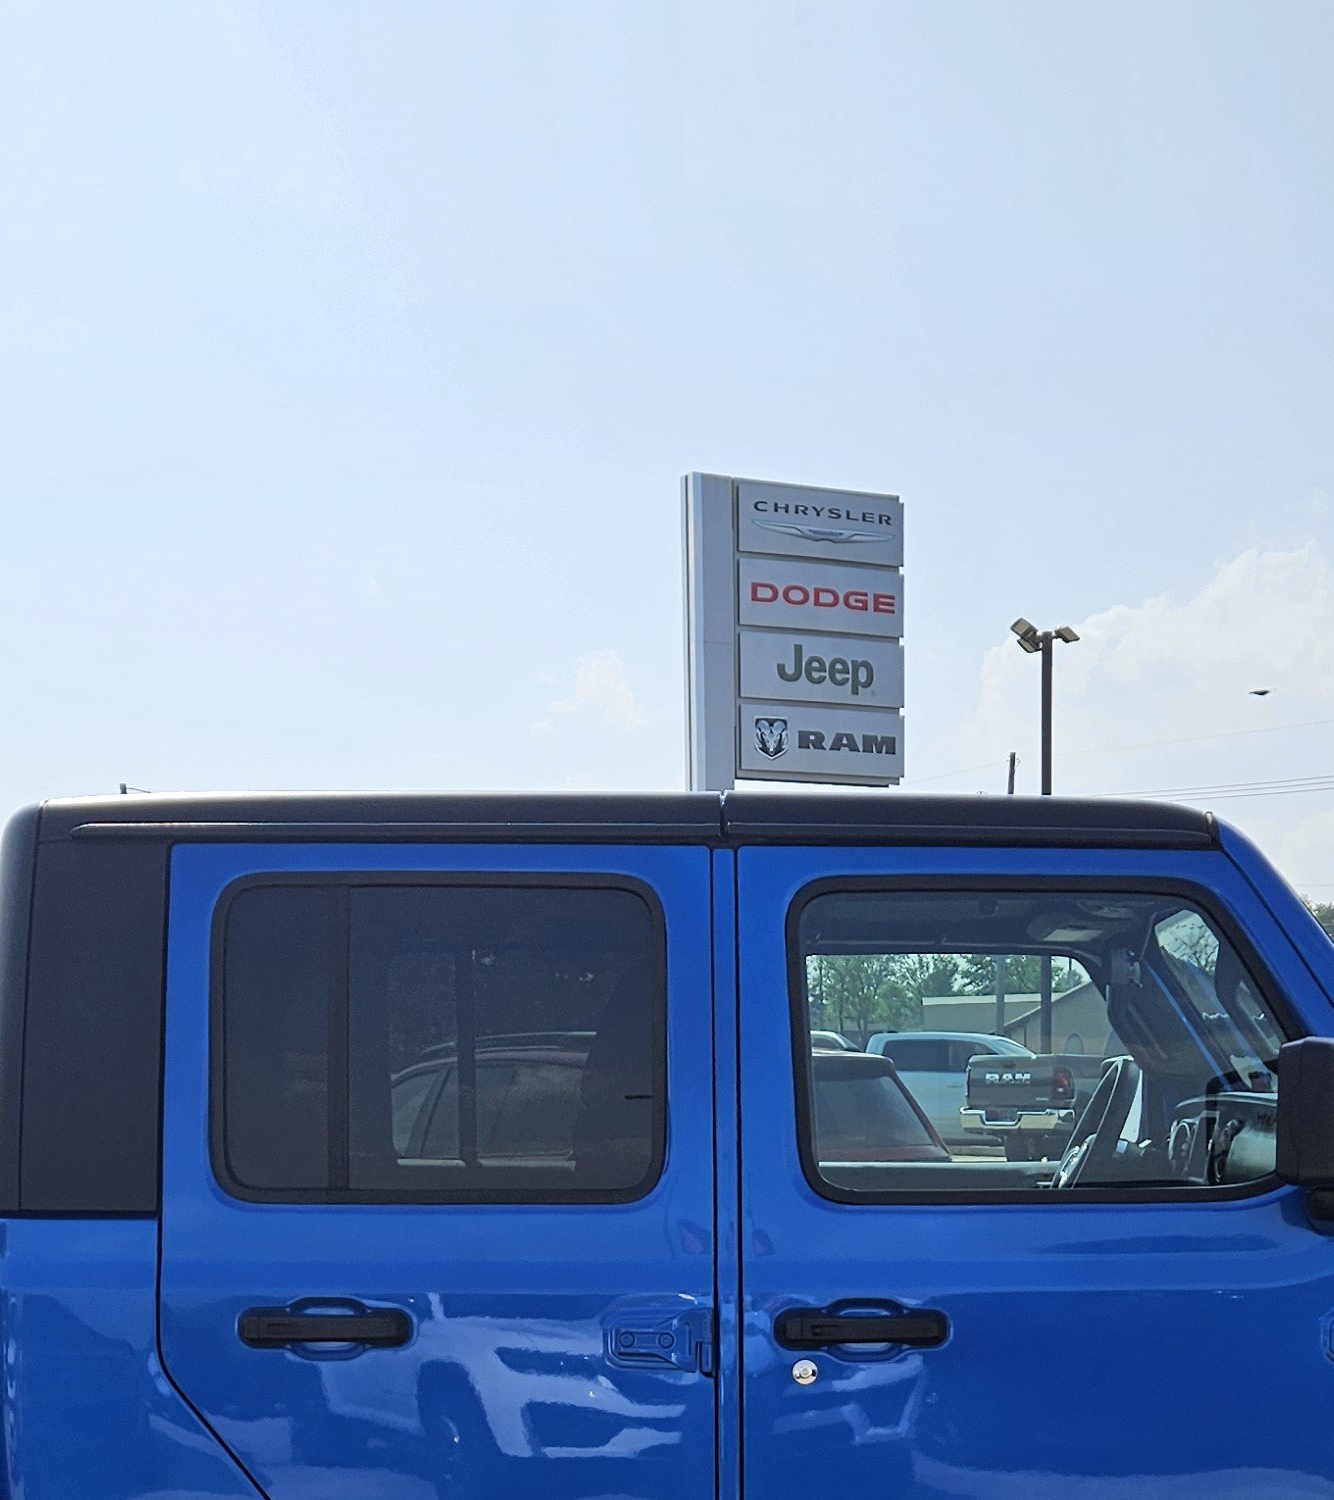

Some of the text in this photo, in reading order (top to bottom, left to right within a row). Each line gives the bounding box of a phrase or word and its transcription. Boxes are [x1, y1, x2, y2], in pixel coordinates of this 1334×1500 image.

[753, 500, 893, 527] CHRYSLER
[751, 582, 896, 614] DODGE
[776, 643, 874, 695] Jeep
[798, 729, 896, 755] RAM
[985, 1073, 1031, 1084] RAM
